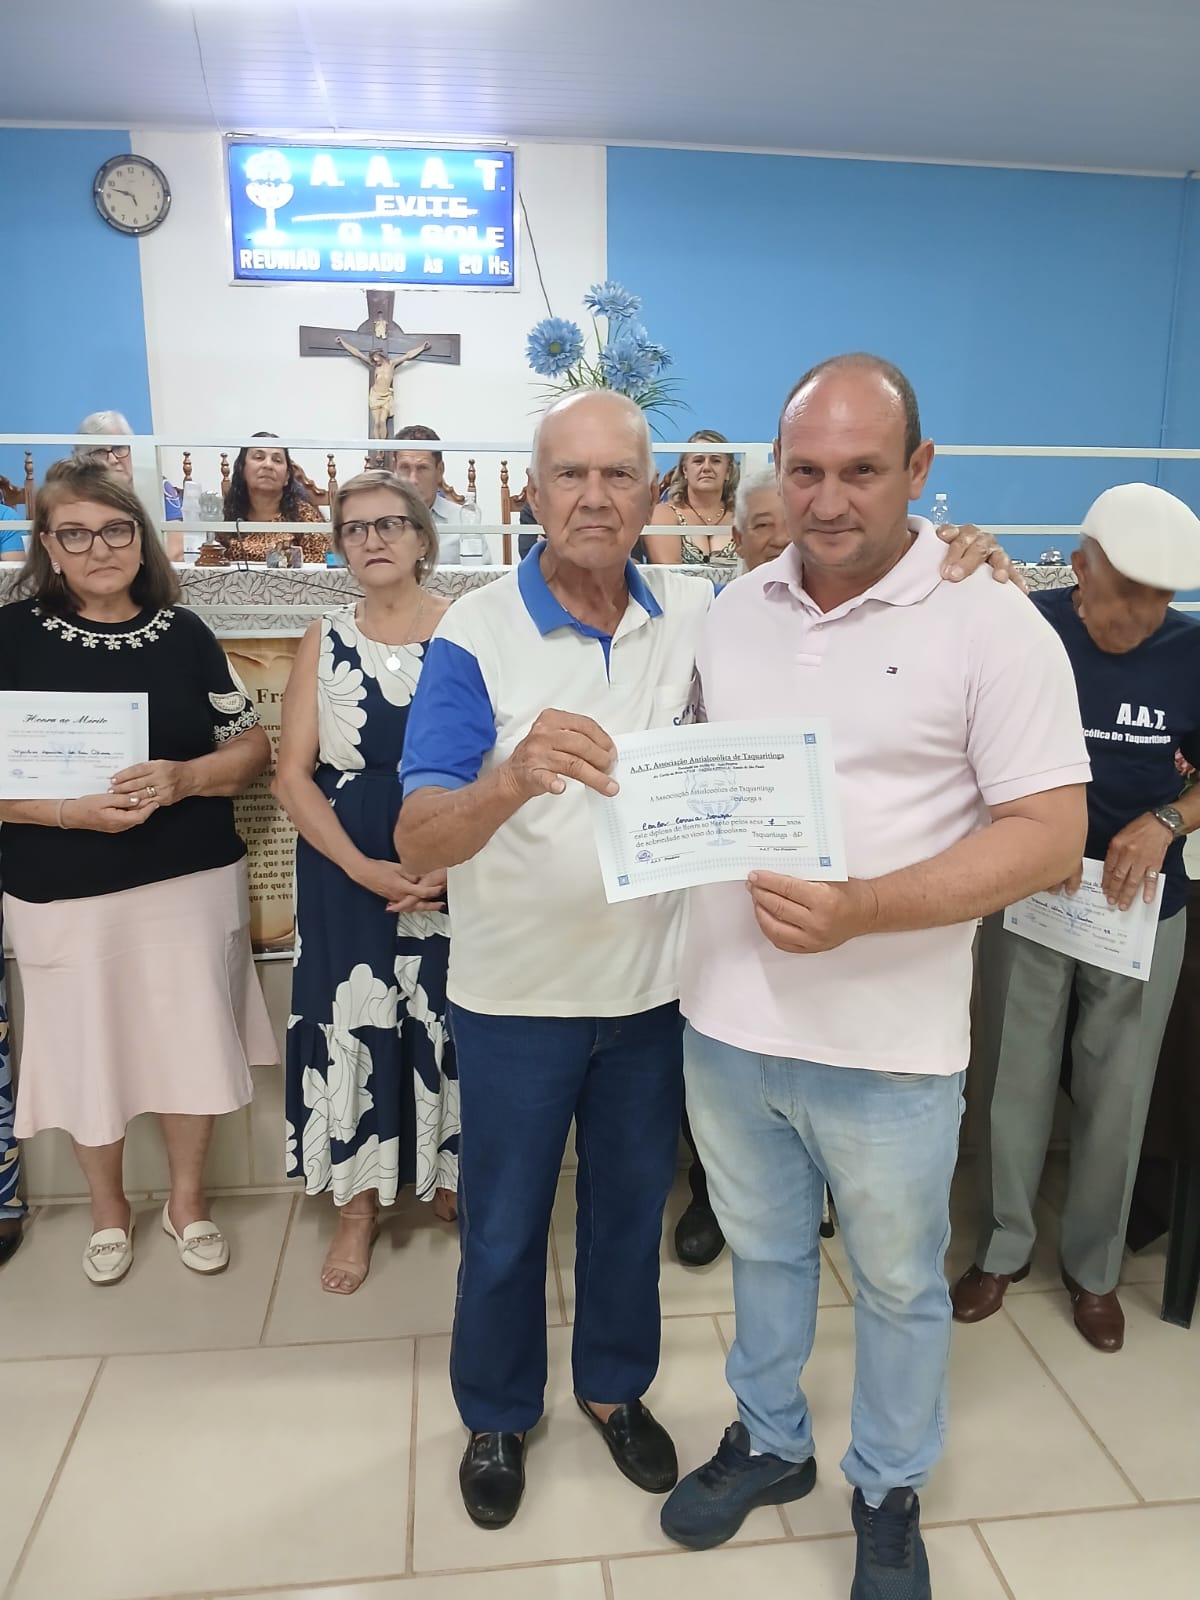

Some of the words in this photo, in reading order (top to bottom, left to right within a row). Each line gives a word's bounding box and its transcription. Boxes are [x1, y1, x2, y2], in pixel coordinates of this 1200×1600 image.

[1081, 728, 1111, 740] cólica
[732, 753, 741, 761] de
[742, 752, 785, 761] Taquaritinga
